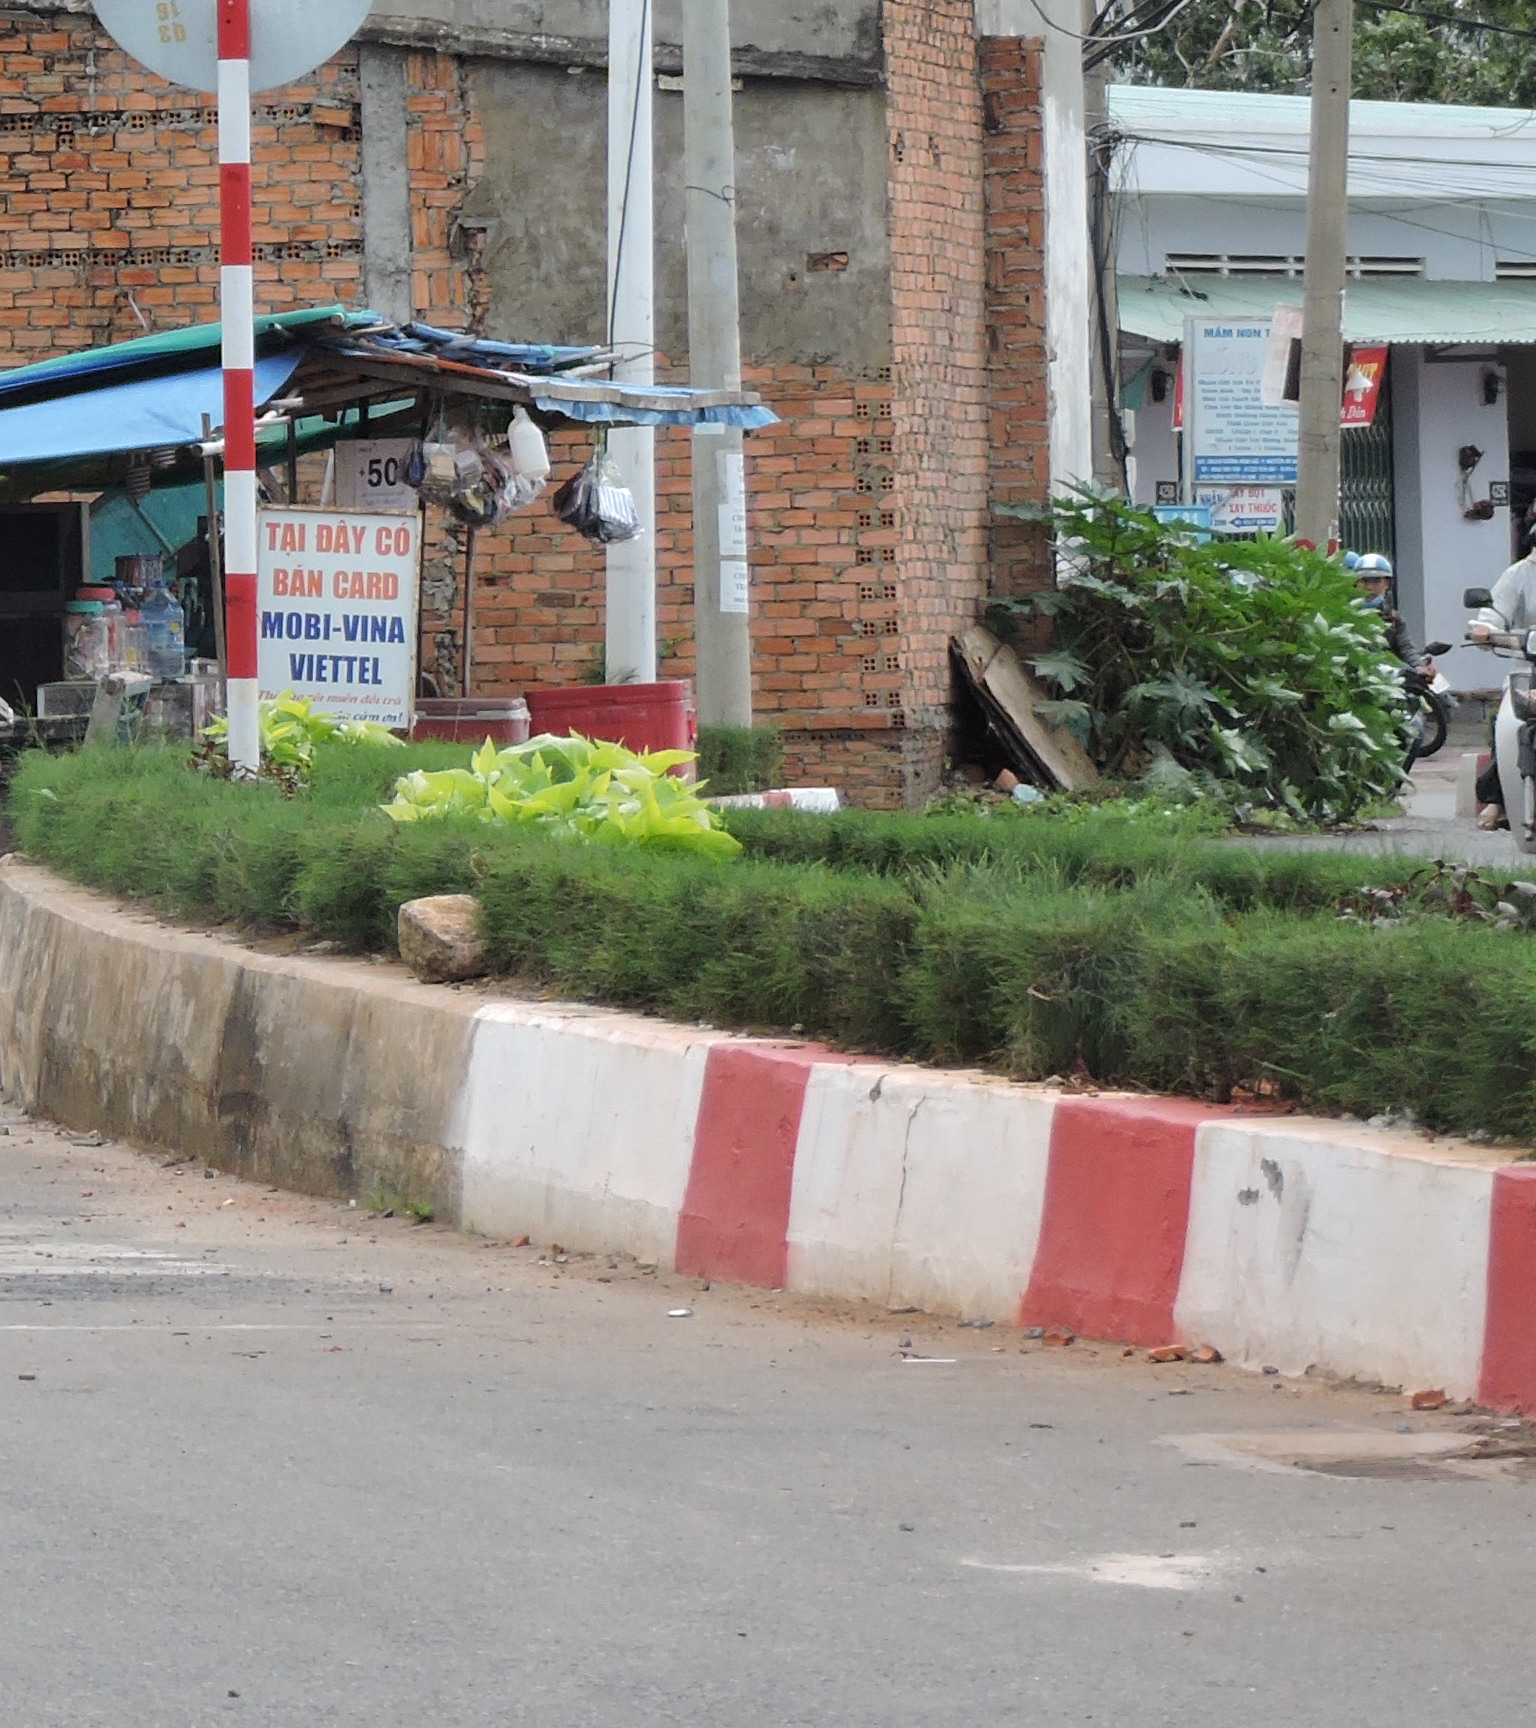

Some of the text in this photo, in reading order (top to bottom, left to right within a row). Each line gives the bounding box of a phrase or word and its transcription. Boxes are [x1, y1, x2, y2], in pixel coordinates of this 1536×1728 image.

[266, 520, 411, 556] TẠI ĐÂY CÓ
[273, 564, 399, 601] BÁN CARD
[261, 611, 406, 644] MOBI-VINA
[289, 653, 383, 685] VIETTEL
